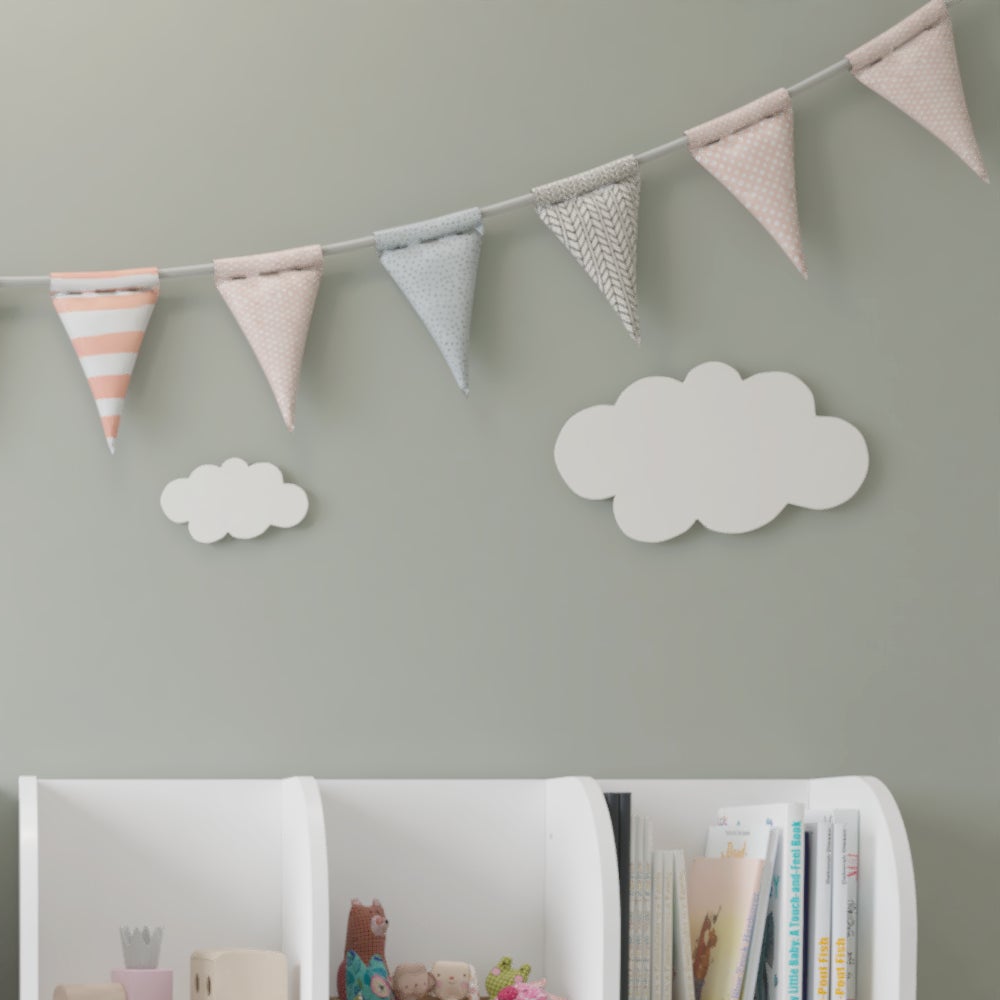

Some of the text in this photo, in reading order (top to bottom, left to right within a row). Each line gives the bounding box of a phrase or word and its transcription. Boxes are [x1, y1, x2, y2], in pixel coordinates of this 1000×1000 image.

[790, 821, 802, 847] Book
[818, 937, 829, 963] Fish
[835, 938, 846, 964] Fish
[788, 968, 799, 994] Little
